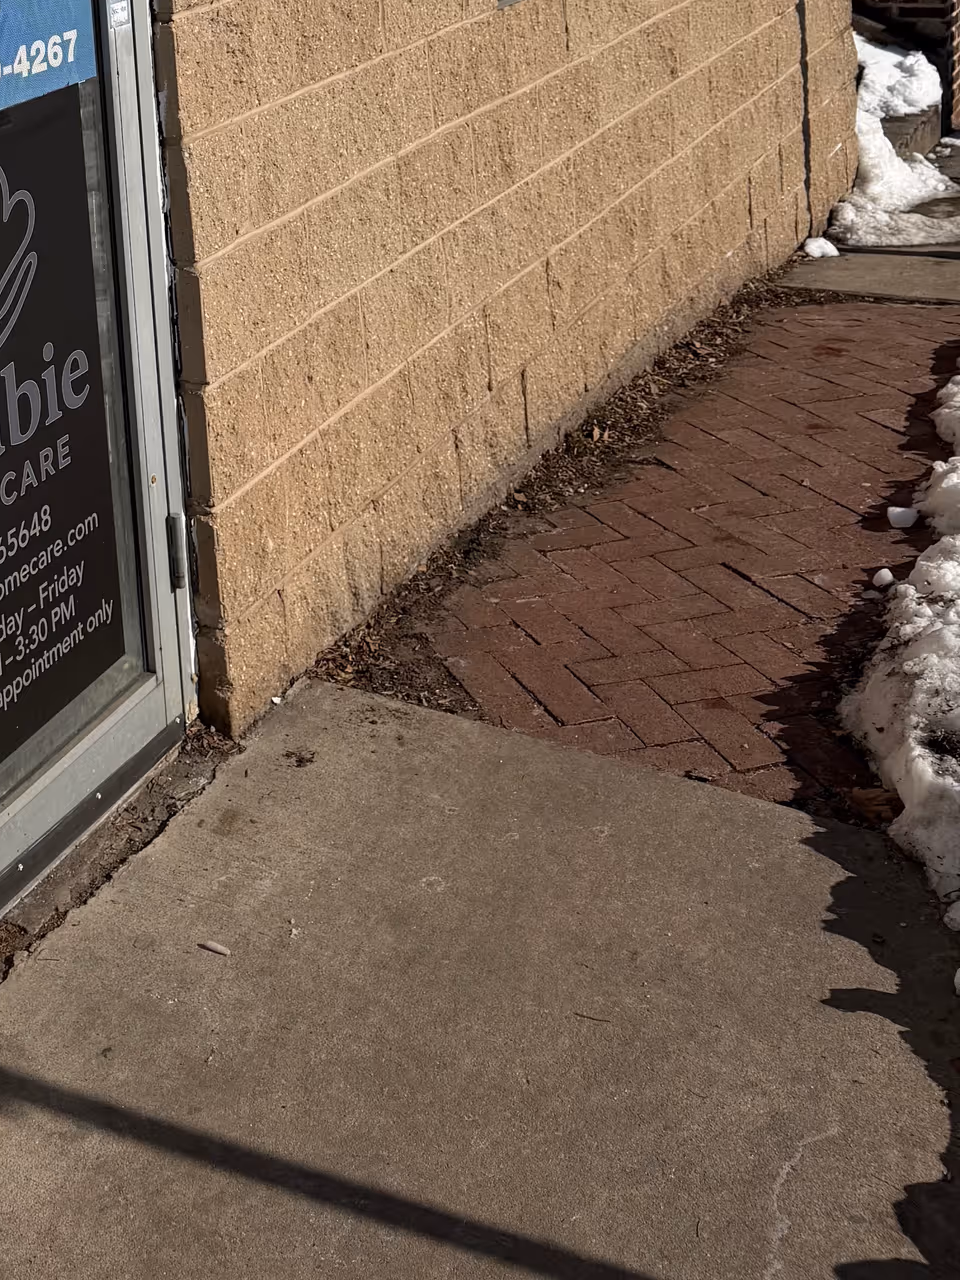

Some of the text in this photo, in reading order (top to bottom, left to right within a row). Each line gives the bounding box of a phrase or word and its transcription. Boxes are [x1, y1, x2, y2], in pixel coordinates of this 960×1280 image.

[0, 434, 72, 506] CARE
[39, 560, 86, 609] Friday
[15, 621, 48, 663] 3:30
[51, 595, 76, 635] PM
[86, 598, 114, 634] only
